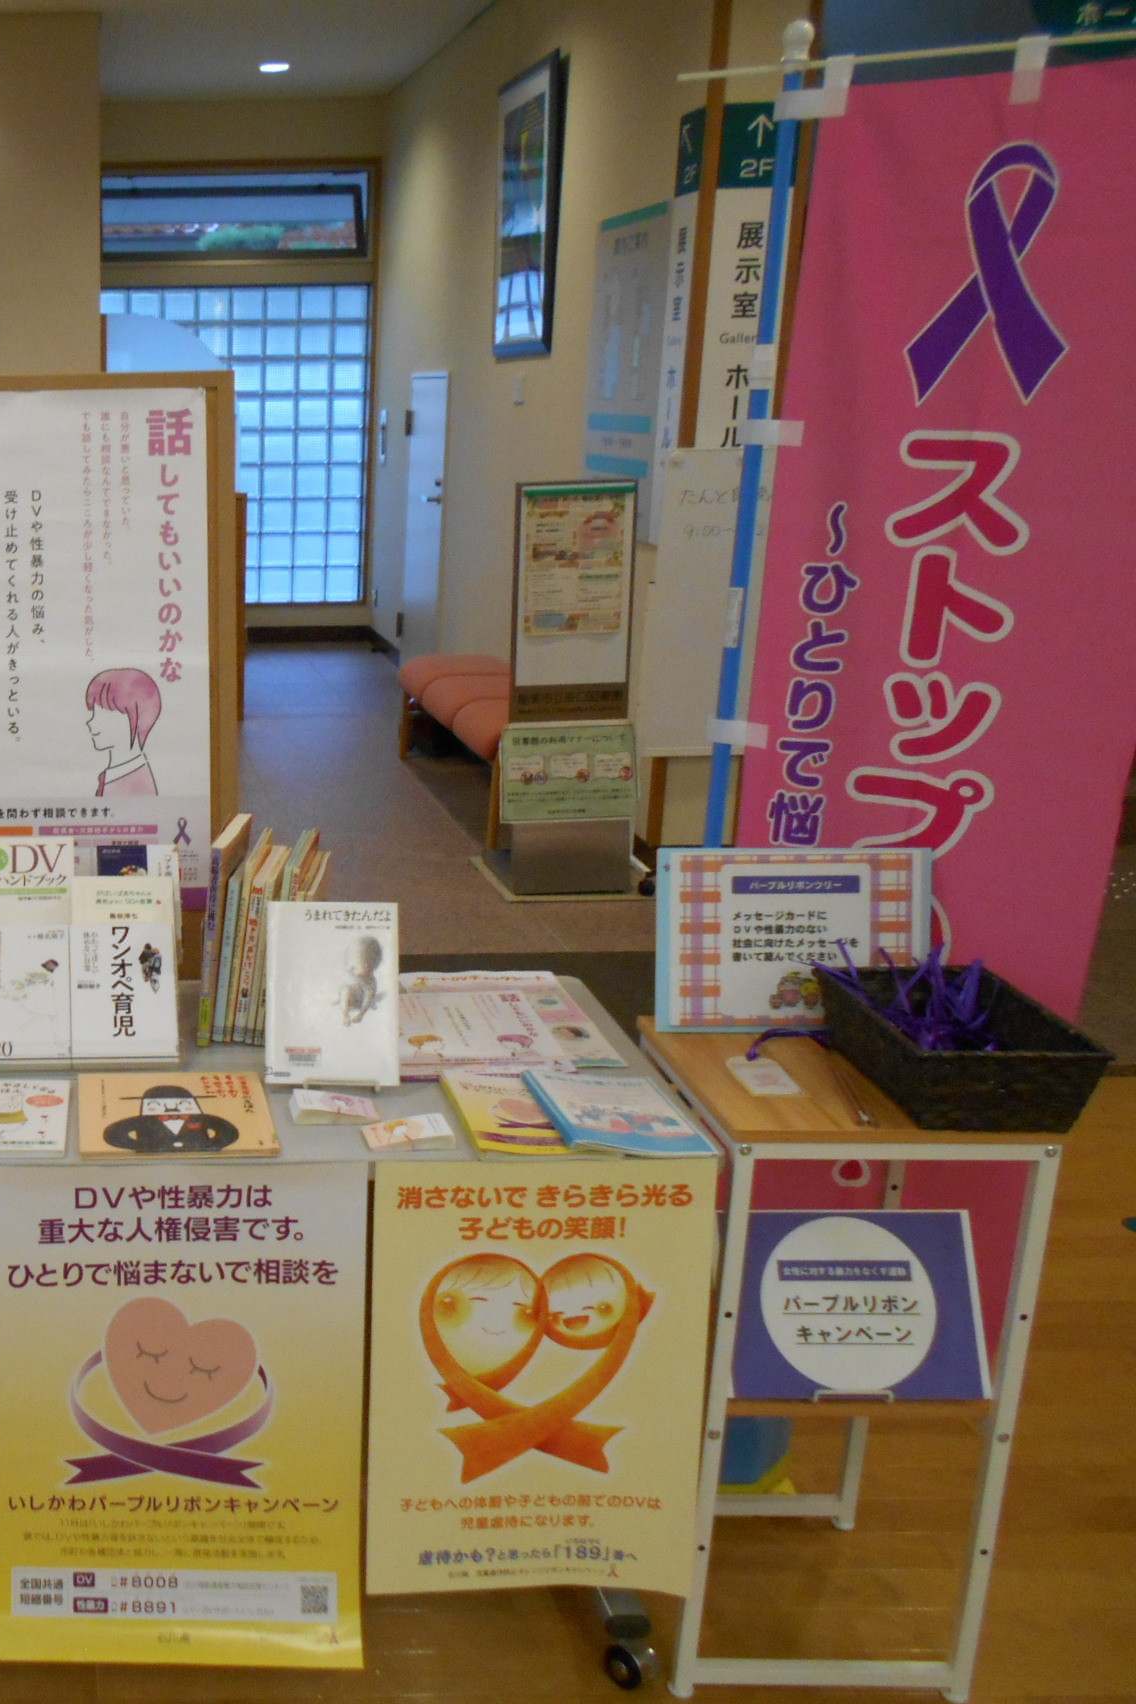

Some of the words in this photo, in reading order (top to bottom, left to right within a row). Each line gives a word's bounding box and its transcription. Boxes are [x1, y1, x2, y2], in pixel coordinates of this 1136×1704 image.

[739, 159, 774, 178] 2F
[730, 222, 764, 320] 展示室
[719, 331, 758, 345] Galler
[145, 408, 194, 683] 話してもいいのかな
[29, 489, 46, 644] DVや性暴力の悩み、
[3, 489, 22, 742] 受け止めてくれる人がきっといる。
[846, 429, 1031, 858] ストップ
[8, 843, 67, 874] DV
[304, 909, 392, 922] うまれてきたんだよ
[732, 911, 827, 921] メッセージカードに
[111, 926, 137, 1037] ワンオペ育児
[73, 1184, 273, 1210] DVや性暴力は
[397, 1185, 528, 1210] 消さないで
[536, 1183, 694, 1209] きらきら光る
[38, 1217, 305, 1245] 重大な人権侵害です。
[7, 1259, 340, 1289] ひとりで悩まないで相談を
[783, 1295, 919, 1313] パープルリボン
[796, 1325, 913, 1343] キャンペーン
[8, 1494, 341, 1513] いしかわパープルリボンキャンペーン
[19, 1577, 64, 1590] 全国共通
[76, 1575, 94, 1585] DV
